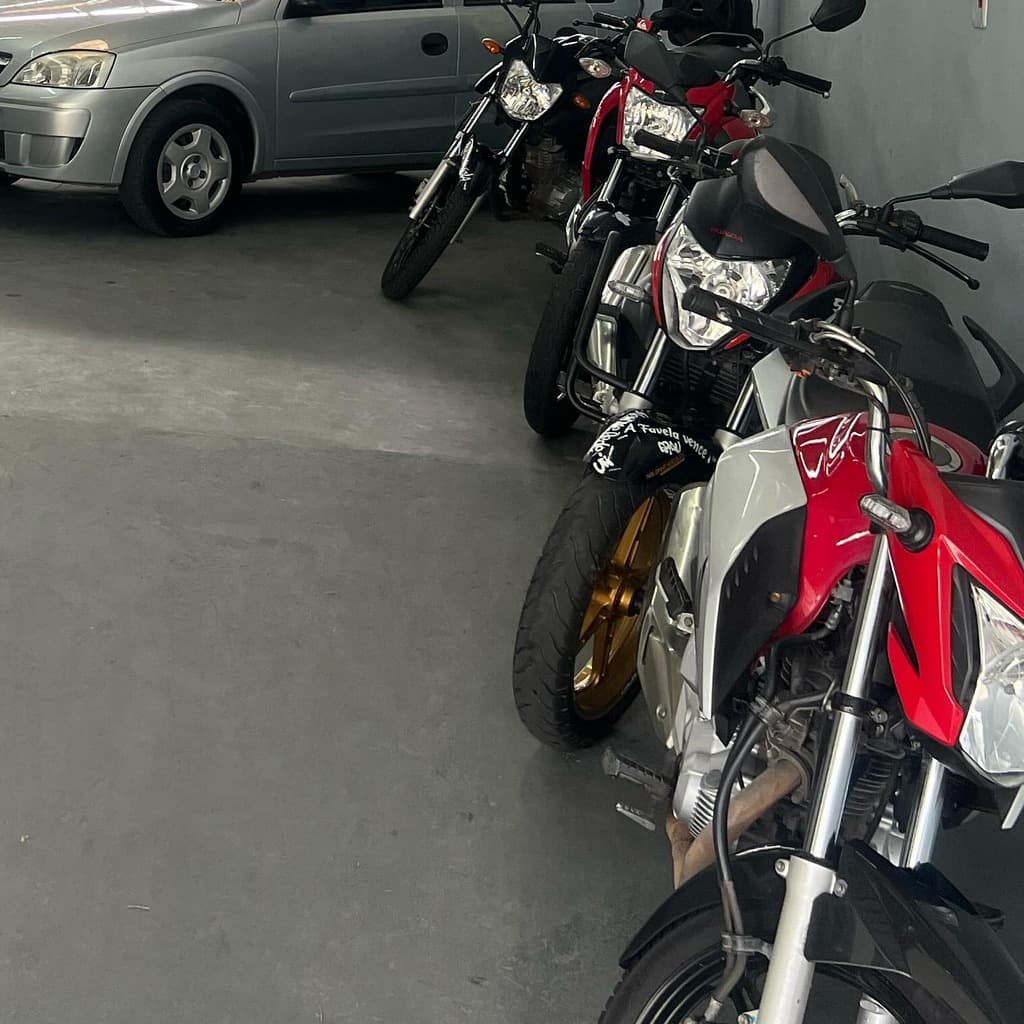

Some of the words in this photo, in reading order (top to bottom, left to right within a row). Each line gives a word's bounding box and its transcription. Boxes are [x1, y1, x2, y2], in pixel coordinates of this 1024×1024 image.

[624, 423, 636, 434] A
[637, 423, 680, 441] Favela
[682, 434, 708, 459] vence
